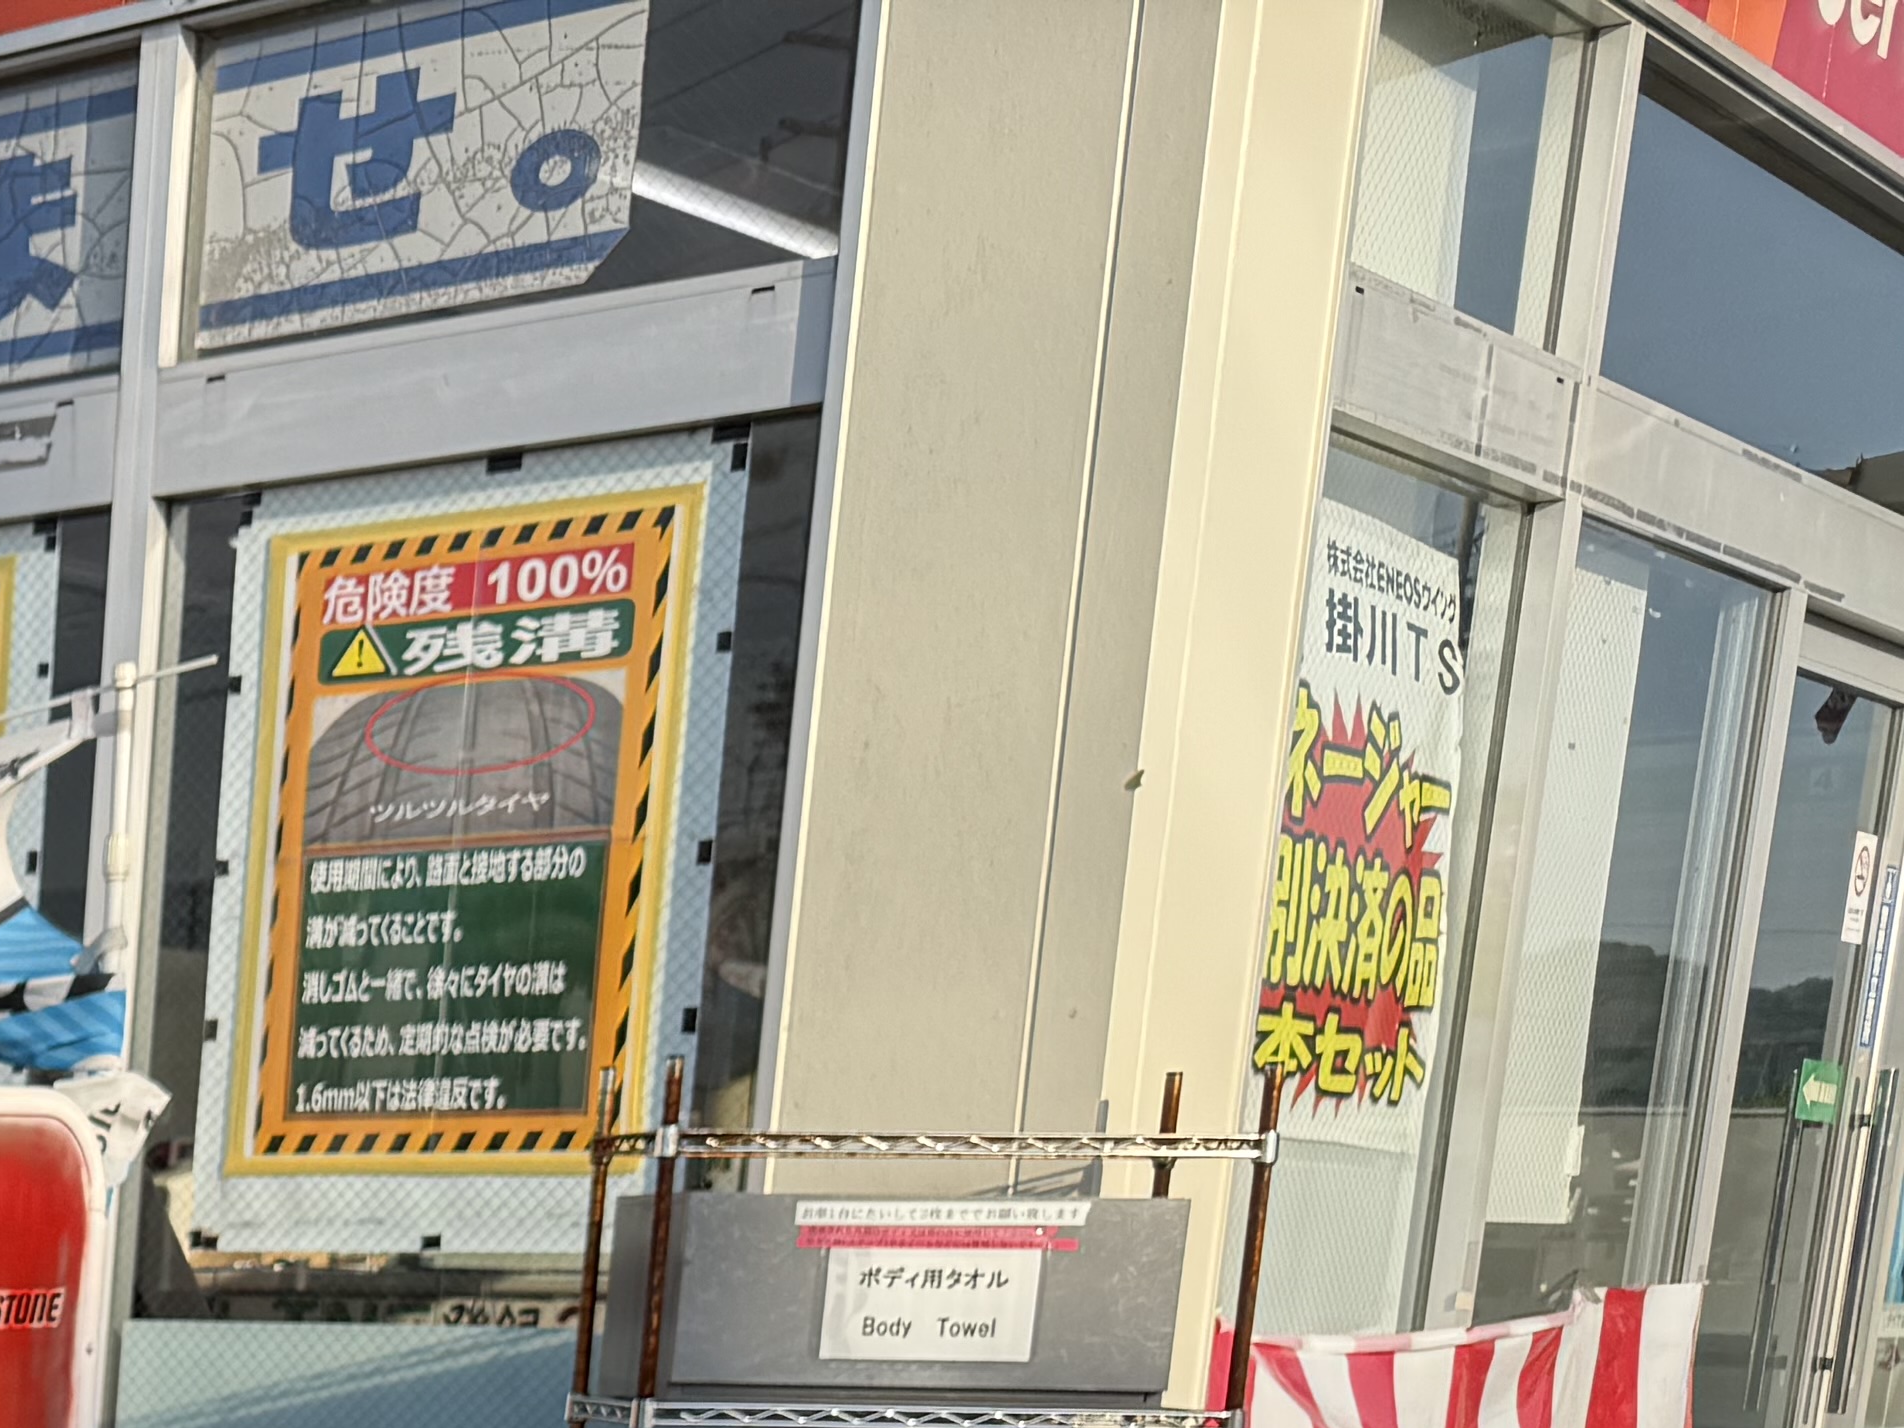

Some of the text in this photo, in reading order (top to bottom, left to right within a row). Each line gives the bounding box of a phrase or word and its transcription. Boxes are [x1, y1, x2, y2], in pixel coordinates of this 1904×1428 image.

[322, 547, 629, 625] 危険度 100%
[400, 608, 620, 676] 残溝
[369, 792, 550, 824] ツルツルタイヤ
[310, 845, 586, 896] 使用期間により、路面と接地する部分の
[306, 910, 463, 950] 溝が減ってくることです。
[859, 1268, 1009, 1291] ボディ用タオル
[861, 1316, 996, 1340] Body Towel
